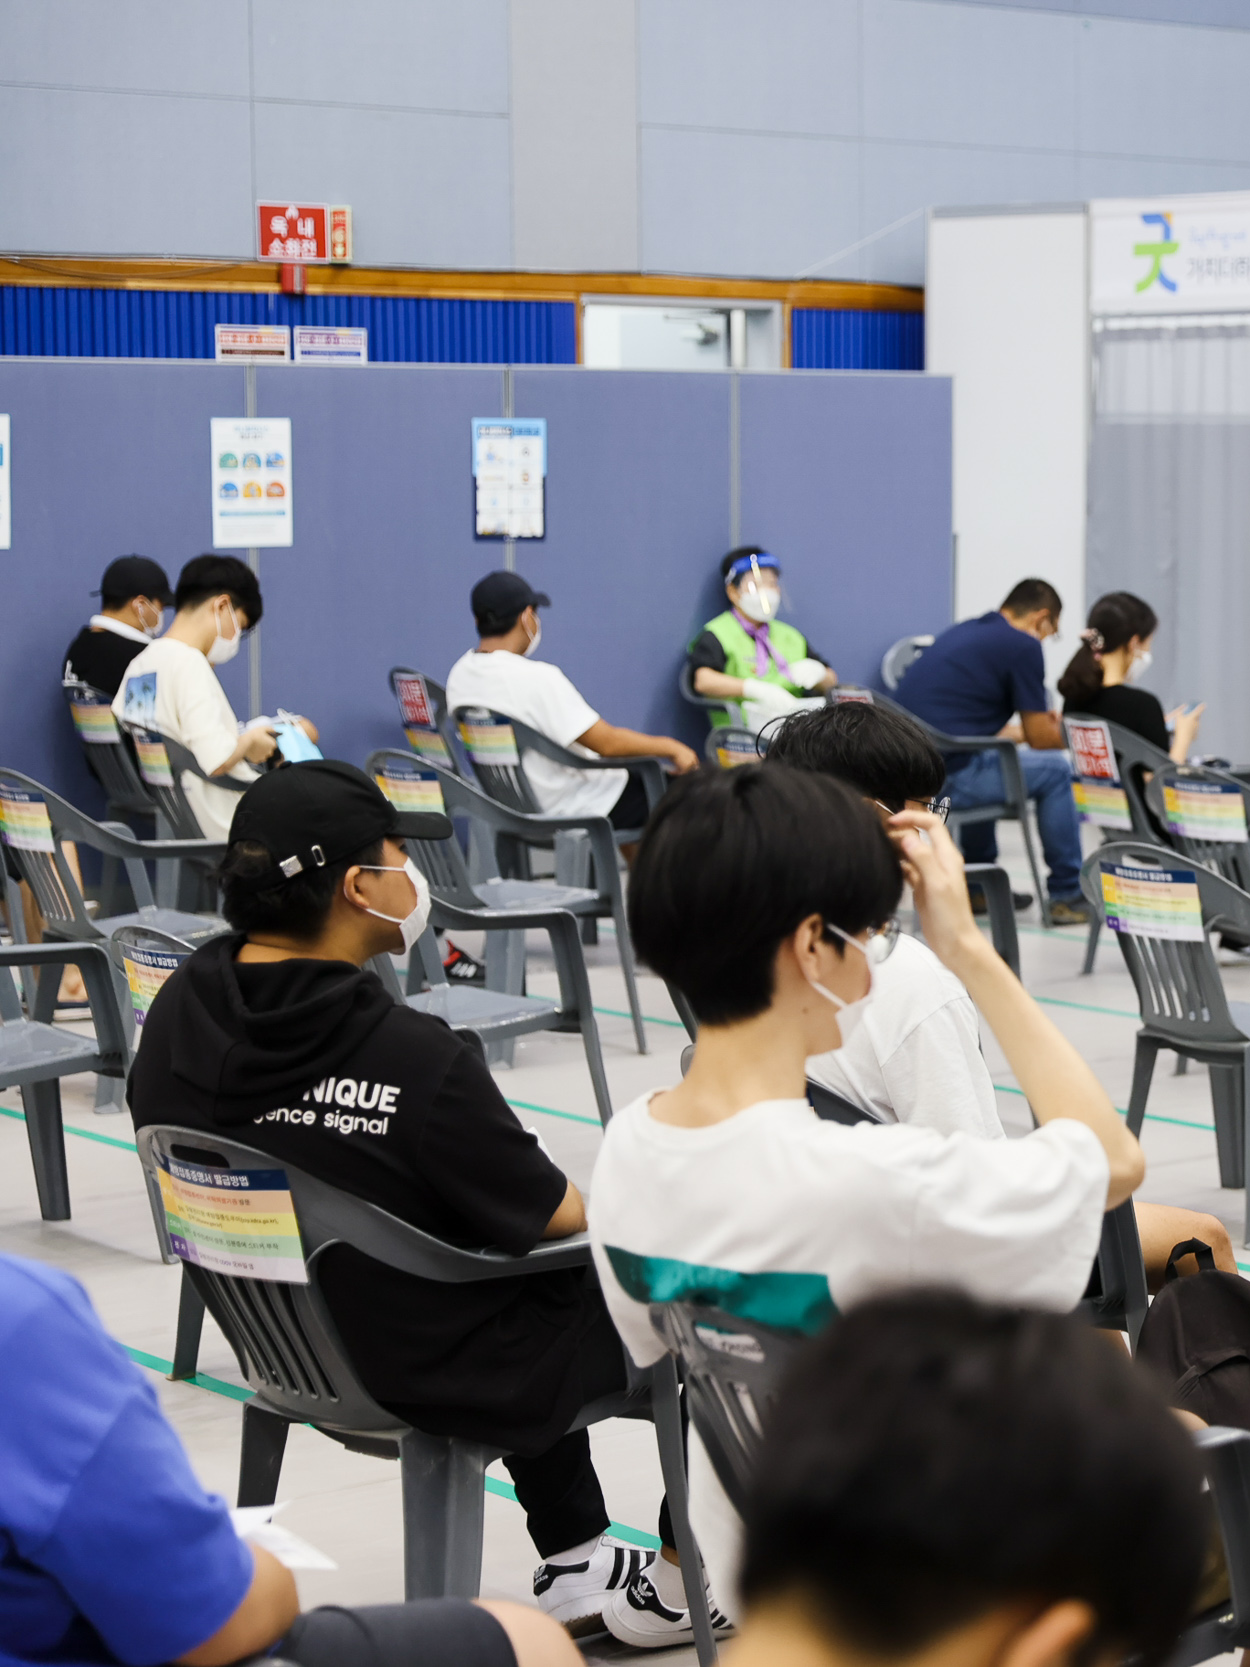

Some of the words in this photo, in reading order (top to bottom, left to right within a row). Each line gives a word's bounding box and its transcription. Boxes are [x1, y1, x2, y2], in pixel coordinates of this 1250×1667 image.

[268, 238, 318, 259] 소화전
[323, 1109, 389, 1135] signal
[213, 1174, 250, 1188] 발급방법
